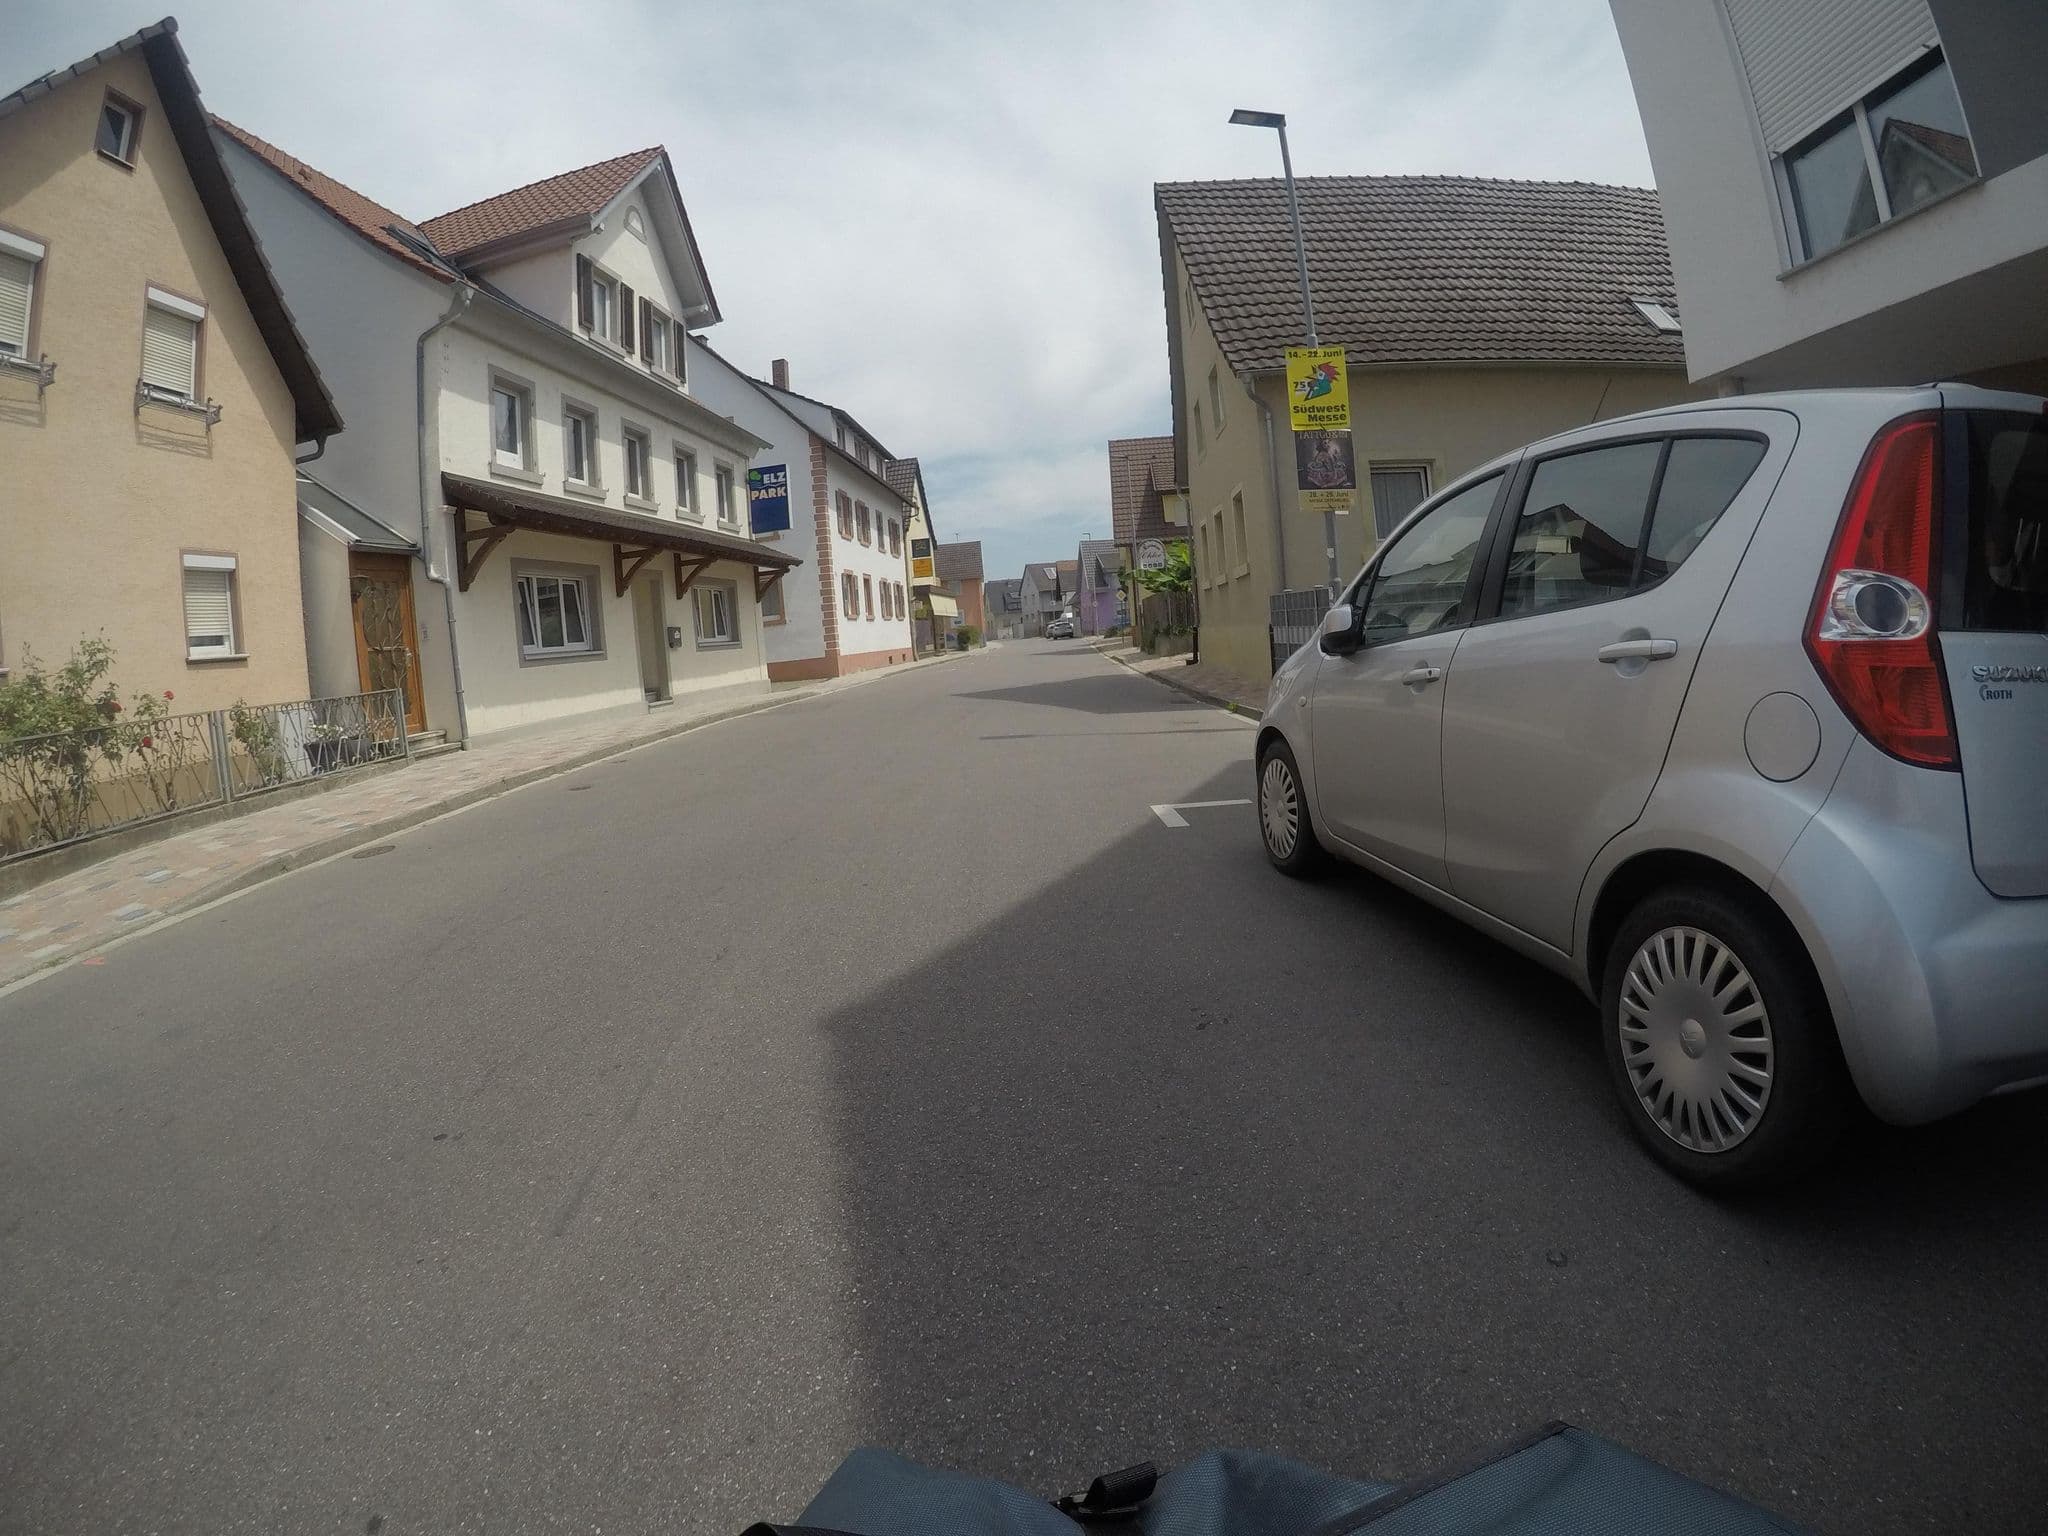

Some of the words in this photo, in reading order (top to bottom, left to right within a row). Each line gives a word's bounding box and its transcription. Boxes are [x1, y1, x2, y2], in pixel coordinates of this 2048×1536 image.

[1322, 349, 1342, 358] Juni
[1293, 381, 1306, 389] 75
[1293, 403, 1346, 414] Südwest
[1307, 413, 1347, 422] Messe
[763, 471, 786, 484] ELZ
[751, 486, 787, 501] PARK
[1972, 665, 2048, 682] SUZUK
[1985, 689, 2013, 700] ROTH
